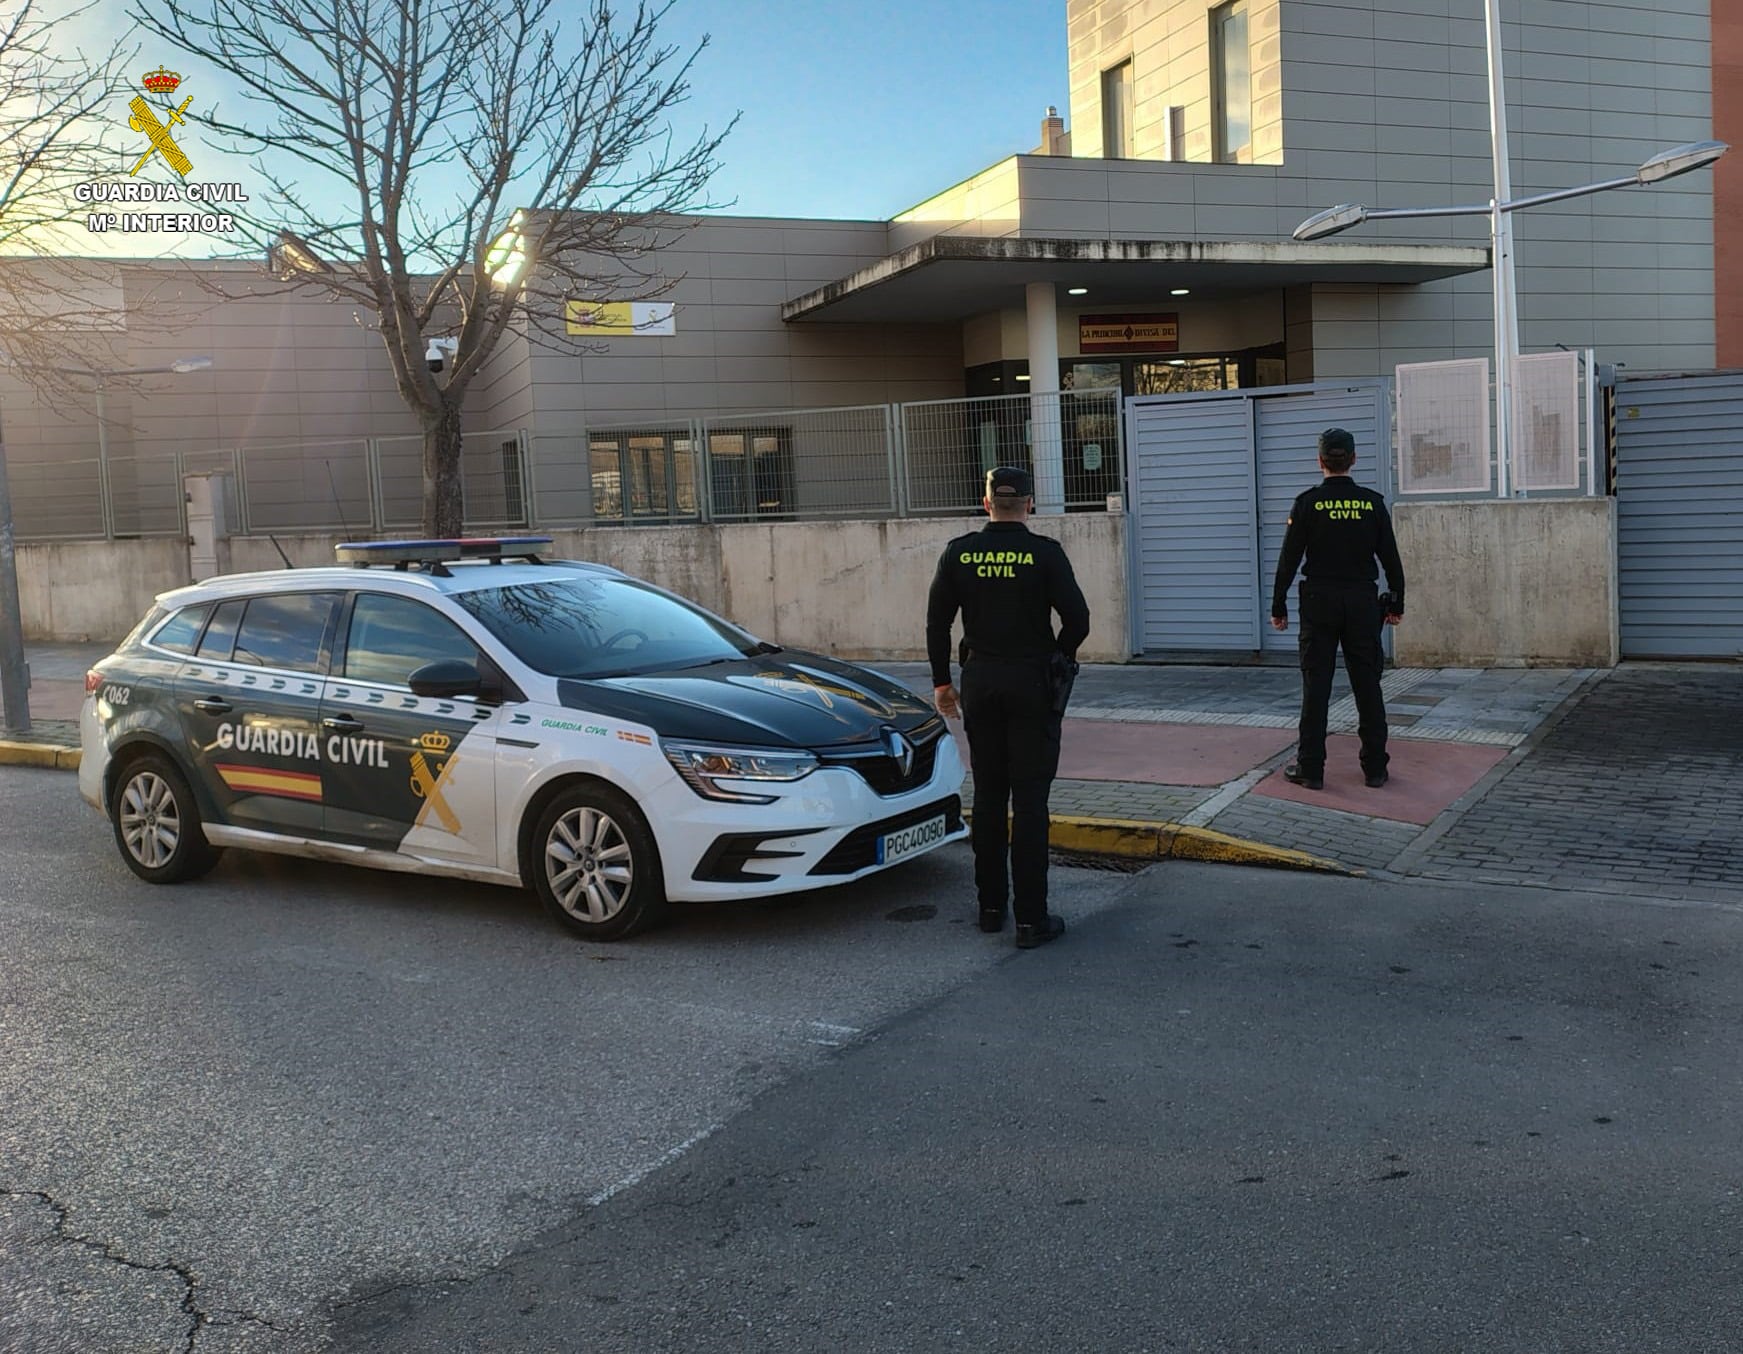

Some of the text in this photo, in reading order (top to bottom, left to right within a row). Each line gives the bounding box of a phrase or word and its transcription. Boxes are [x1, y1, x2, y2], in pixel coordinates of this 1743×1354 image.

[1081, 330, 1091, 339] LA
[1162, 327, 1176, 336] DEL
[1314, 499, 1374, 511] GUARDIA
[1329, 510, 1362, 520] CIVIL
[959, 551, 1034, 565] GUARDIA
[976, 565, 1016, 578] CIVIL
[541, 719, 609, 737] GUARDIA CIVIL
[216, 722, 390, 769] GUARDIA CIVIL
[886, 818, 944, 858] PGC4009G
